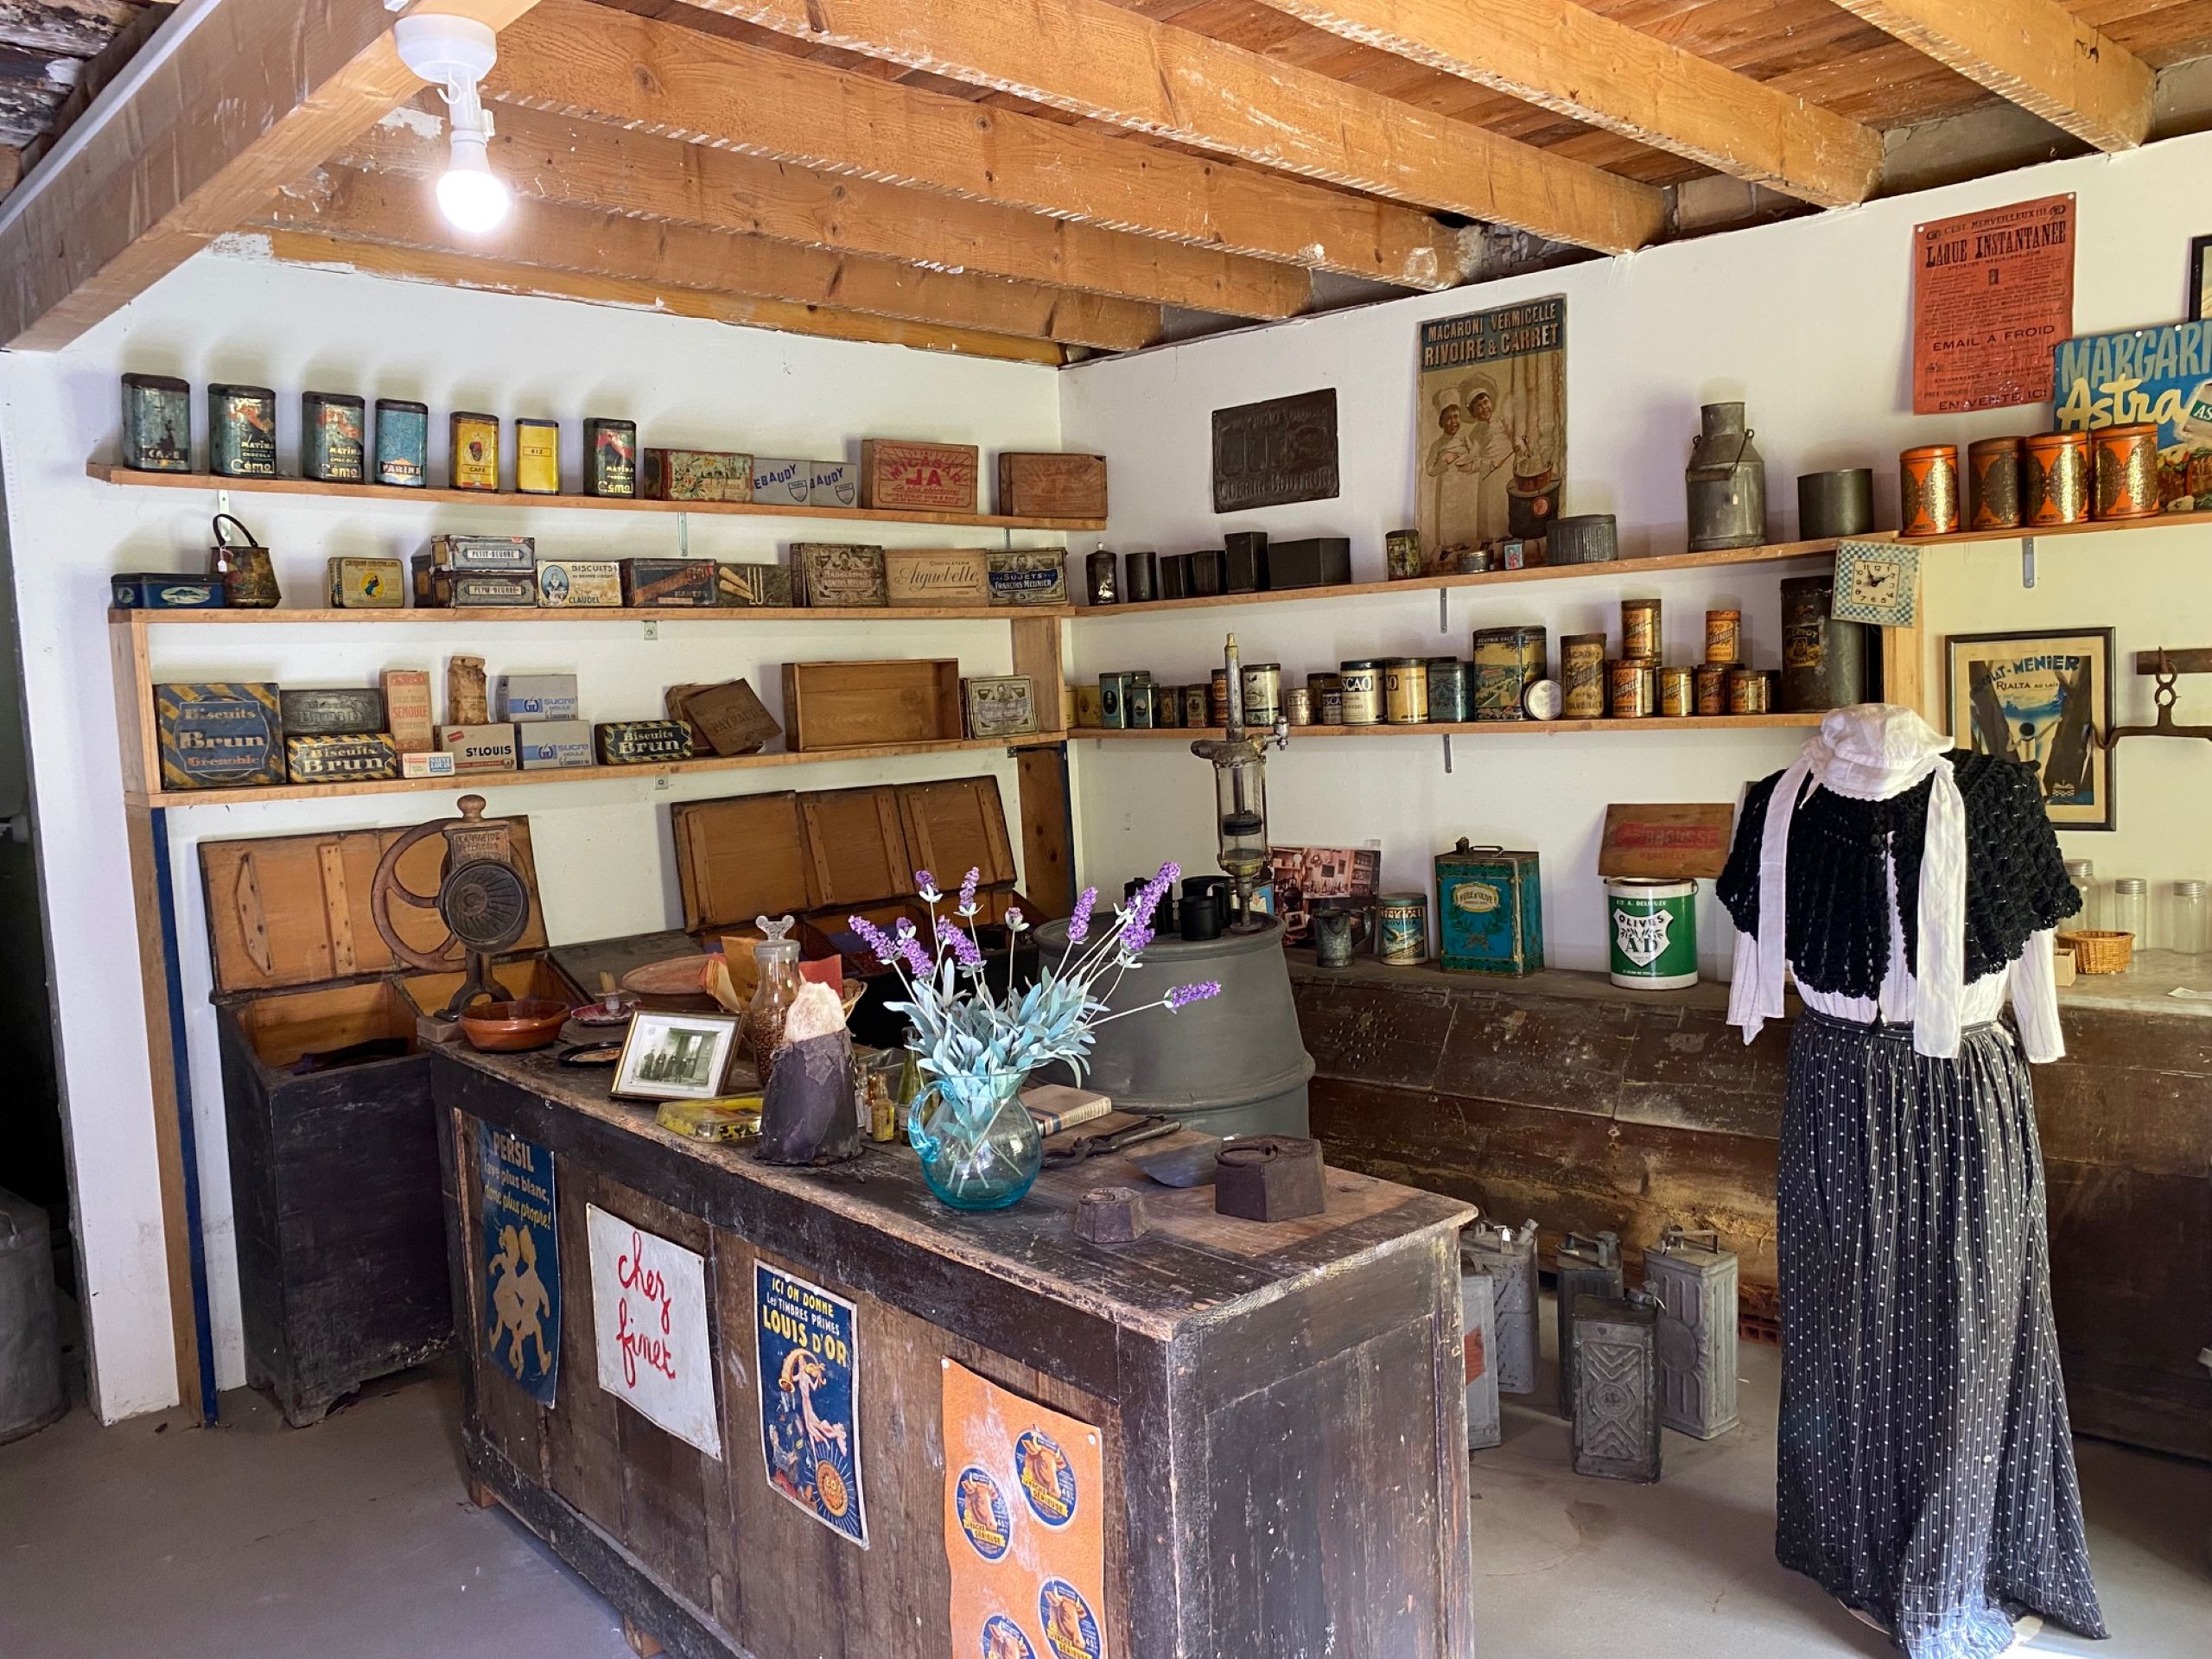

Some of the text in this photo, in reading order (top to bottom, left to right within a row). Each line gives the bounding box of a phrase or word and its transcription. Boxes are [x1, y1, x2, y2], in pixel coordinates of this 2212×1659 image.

[1925, 239, 1967, 268] LAQUE
[1427, 302, 1556, 342] MACARONI VERMICELLE
[1424, 323, 1559, 367] RIVOIRE & CARRET
[1933, 338, 1980, 352] EMAIL
[2005, 325, 2055, 340] FROID
[1939, 401, 1960, 410] EN
[2056, 373, 2188, 430] Astra
[148, 449, 180, 459] CAE
[754, 464, 797, 490] EBAUDY
[810, 467, 843, 489] BAUDY
[906, 468, 943, 486] JA
[471, 550, 515, 559] PETIT-BEURRE
[1024, 579, 1052, 588] MEUNIER
[184, 707, 257, 721] Biscuits
[393, 704, 429, 719] SEMOULE
[179, 732, 266, 750] Brun
[623, 730, 674, 742] Biscuits
[310, 747, 377, 759] Biscuits
[479, 745, 512, 757] LOUIS
[619, 740, 681, 754] Brun
[188, 753, 259, 766] Grenoble
[304, 757, 385, 773] Brun
[1618, 914, 1664, 928] OLIVES
[493, 1131, 534, 1173] PERSIL
[485, 1157, 550, 1206] lave plus blanc,
[503, 1191, 519, 1214] plus
[521, 1203, 551, 1230] propre!
[618, 1230, 671, 1335] chez
[772, 1278, 834, 1319] ICI ON DONNE
[766, 1292, 840, 1336] Les TIMBRES PRIMES
[616, 1297, 677, 1389] finet
[763, 1304, 847, 1368] LOUIS D'OR
